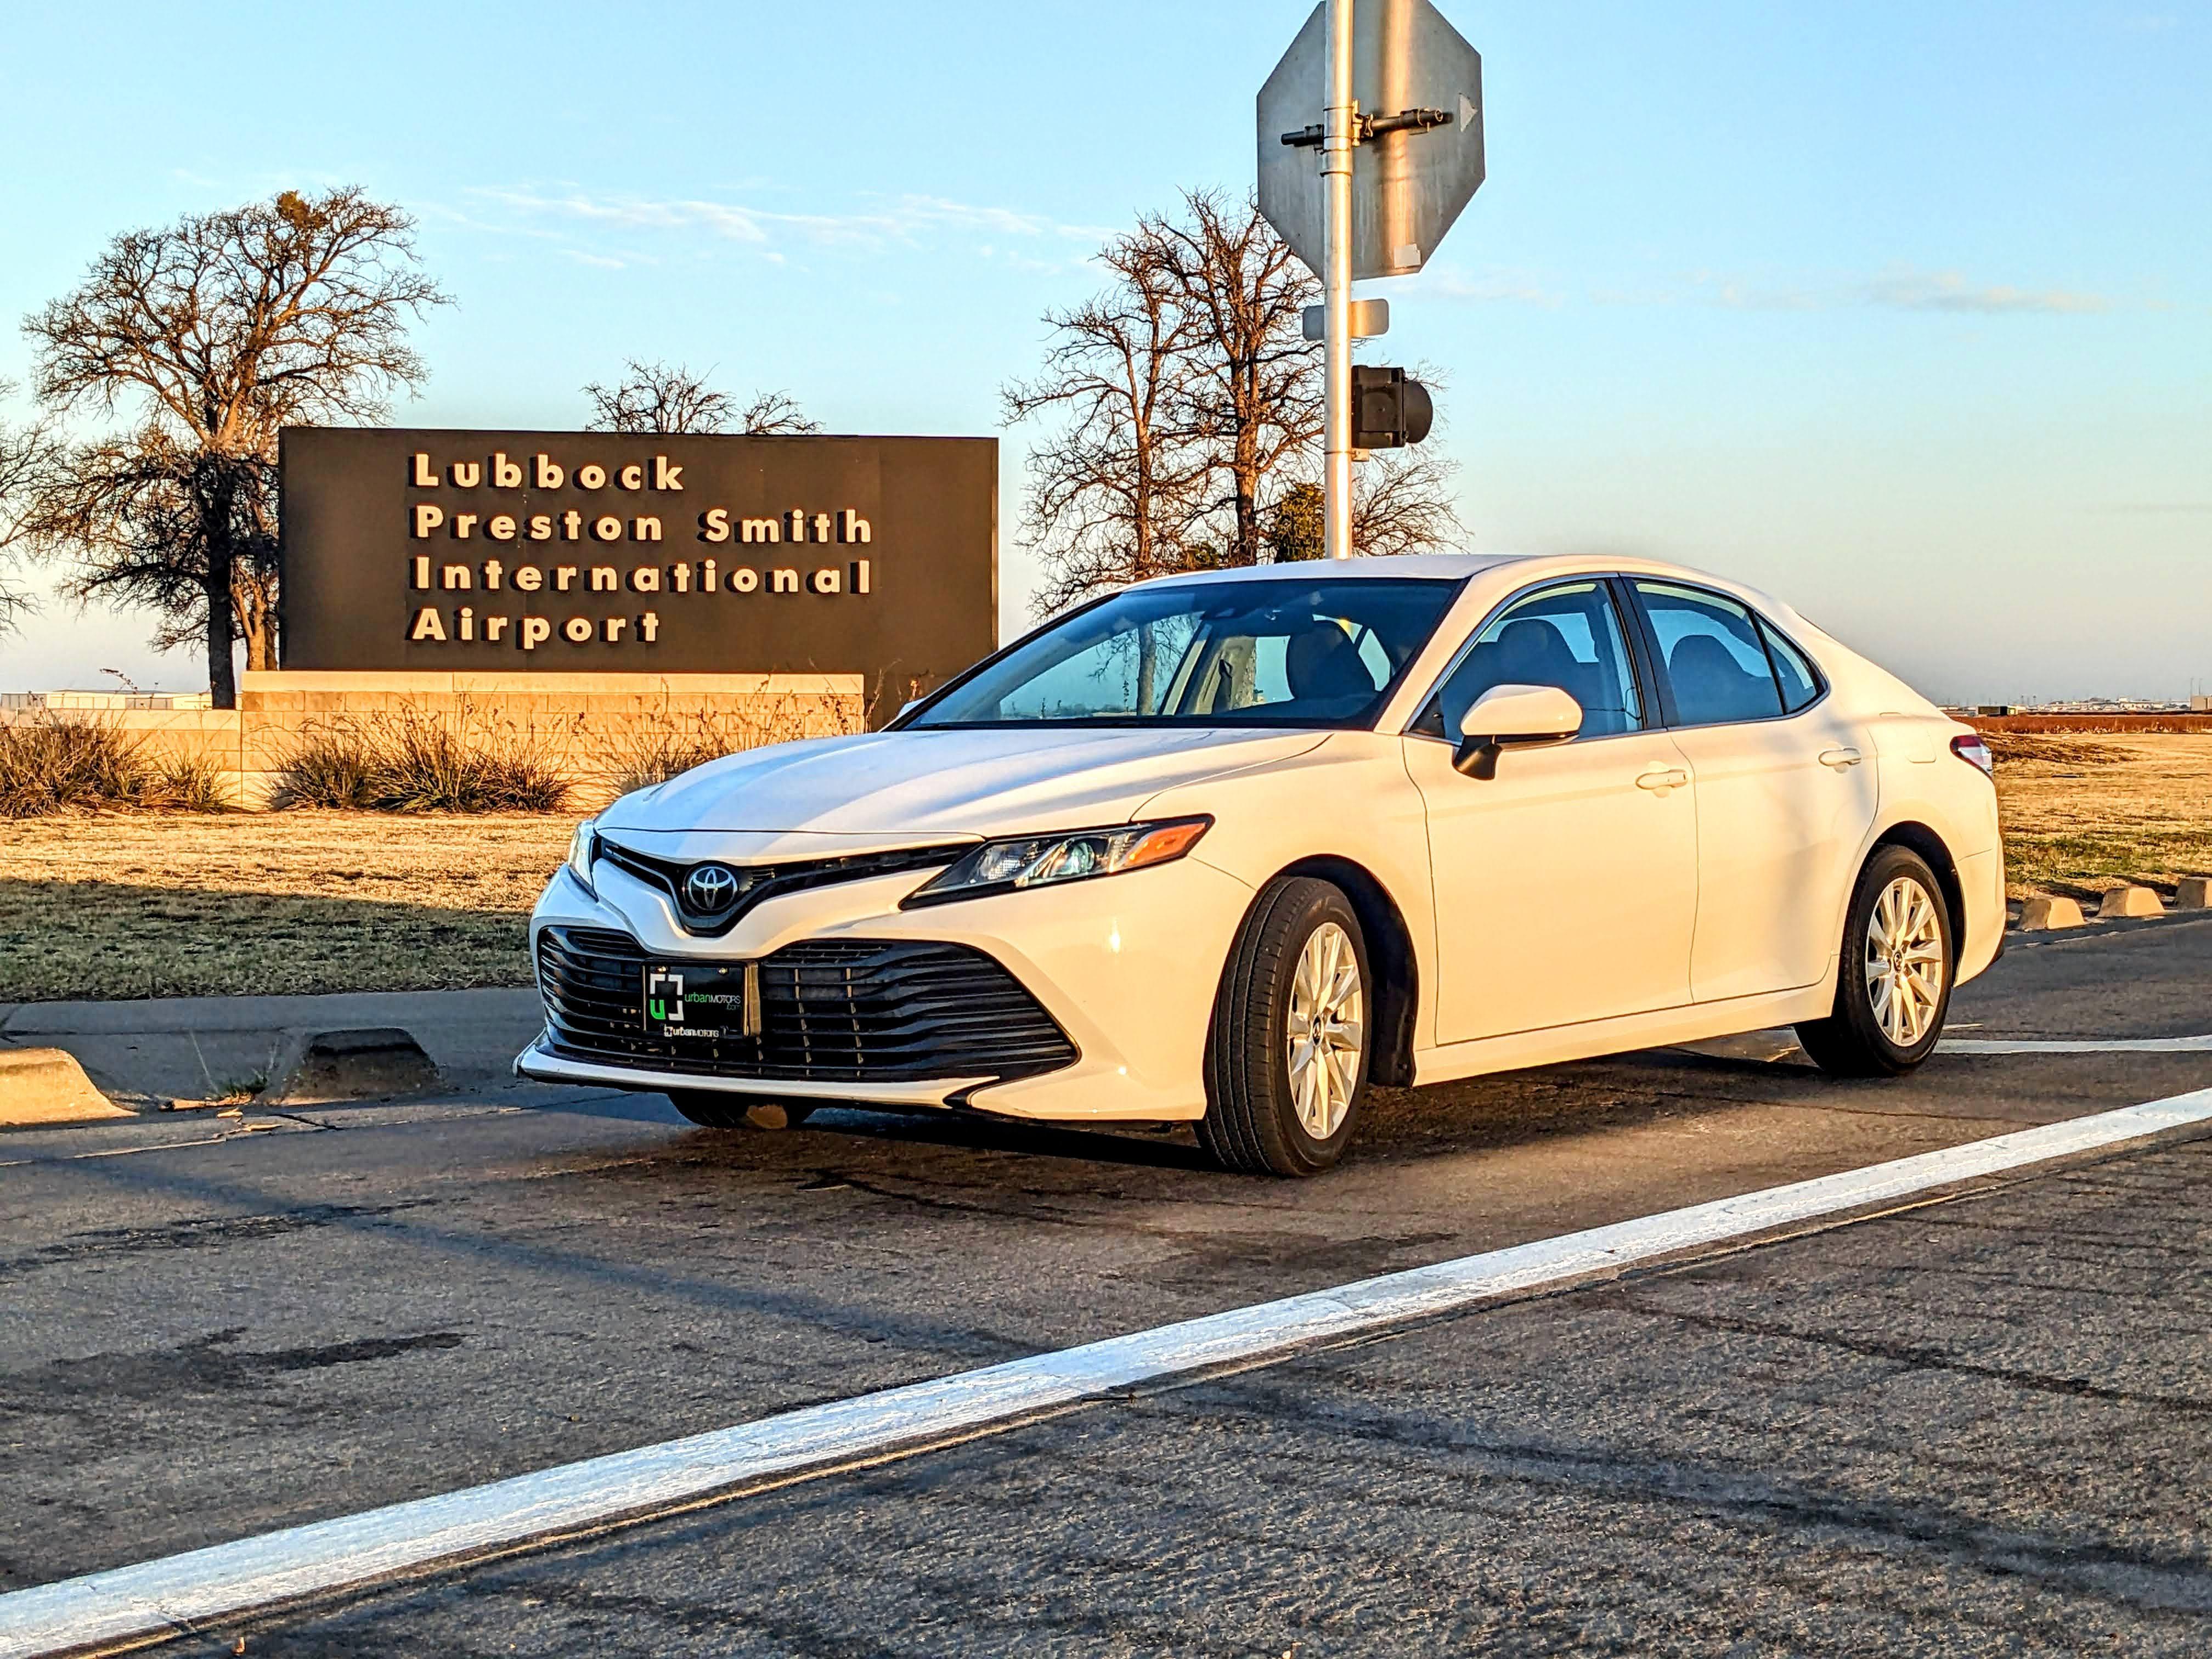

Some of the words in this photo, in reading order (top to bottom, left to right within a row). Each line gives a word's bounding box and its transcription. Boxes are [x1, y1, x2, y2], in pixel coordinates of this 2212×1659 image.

[415, 453, 684, 490] Lubbock
[416, 504, 663, 541] Preston
[704, 507, 872, 544] Smith
[416, 555, 871, 594] International
[411, 607, 660, 650] Airport
